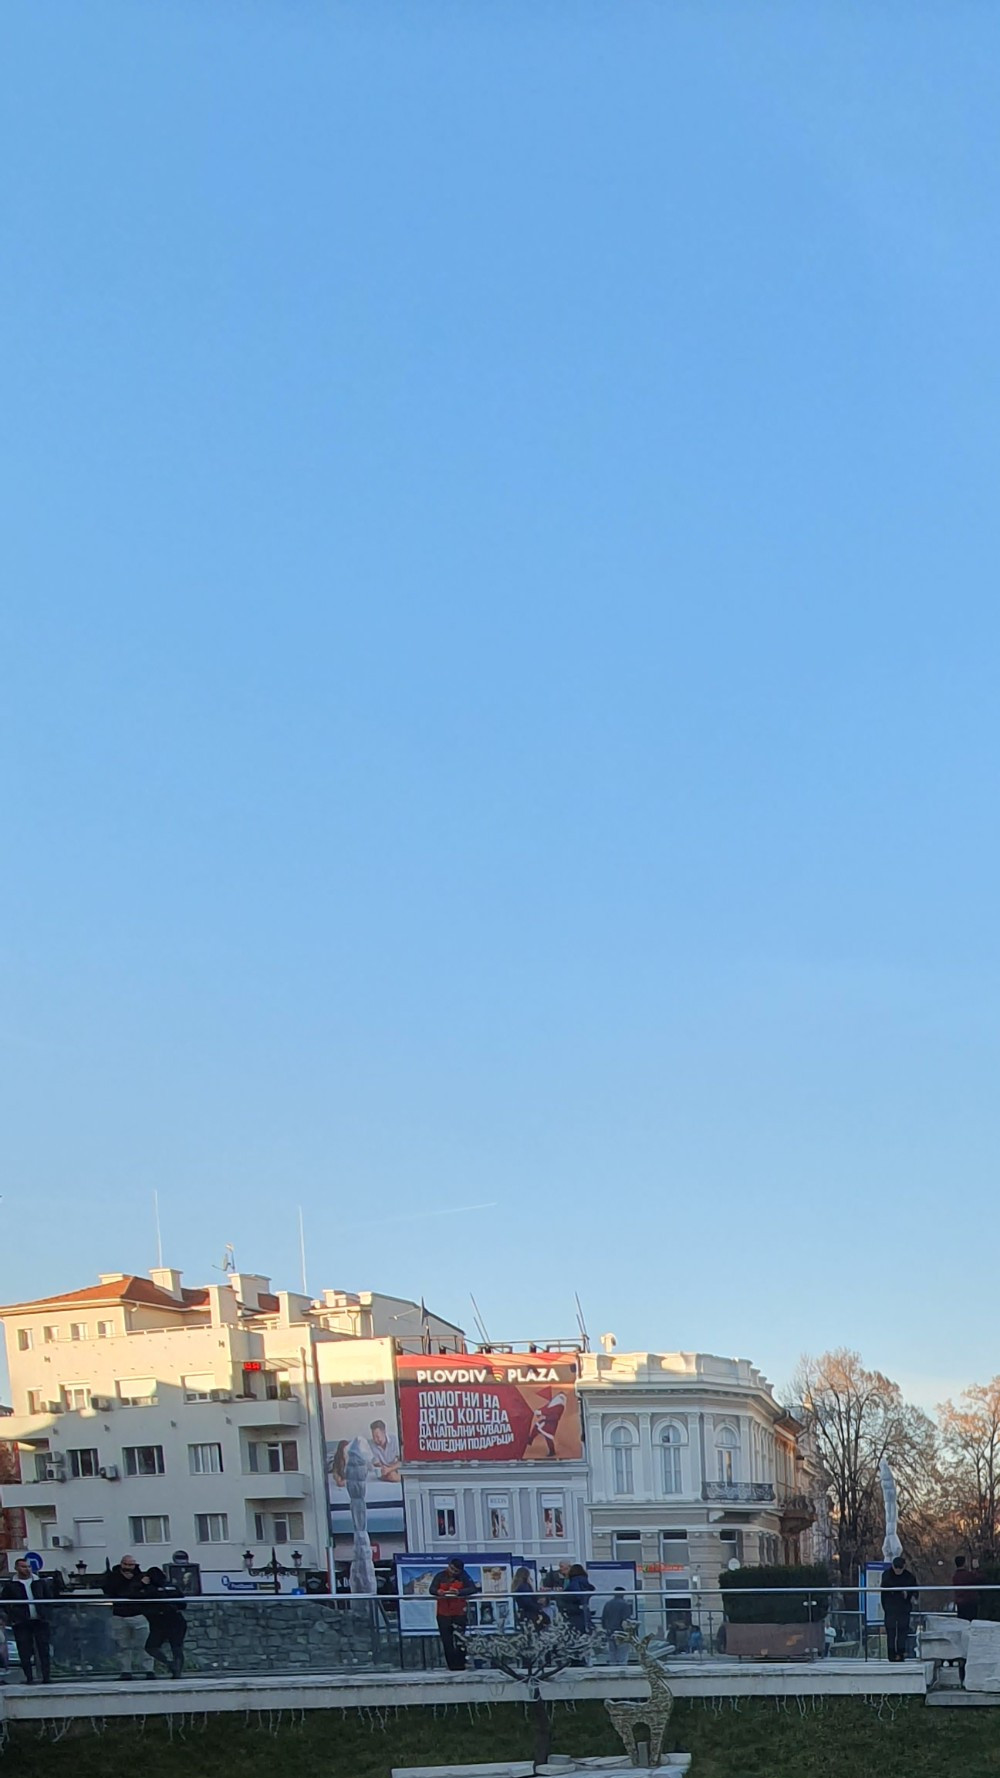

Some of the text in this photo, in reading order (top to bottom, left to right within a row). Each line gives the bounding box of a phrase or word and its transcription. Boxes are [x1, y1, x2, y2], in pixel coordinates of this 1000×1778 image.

[416, 1368, 559, 1383] PLOVDIV PLAZA
[418, 1390, 500, 1409] ПОМОГНИ НА
[418, 1408, 509, 1425] ДЯДО КОЛЕДА
[418, 1422, 512, 1439] ДА НАПЪЛНИ ЧУВАЛА
[419, 1433, 515, 1452] С КОЛЕДНИ ПОДАРЪЦИ
